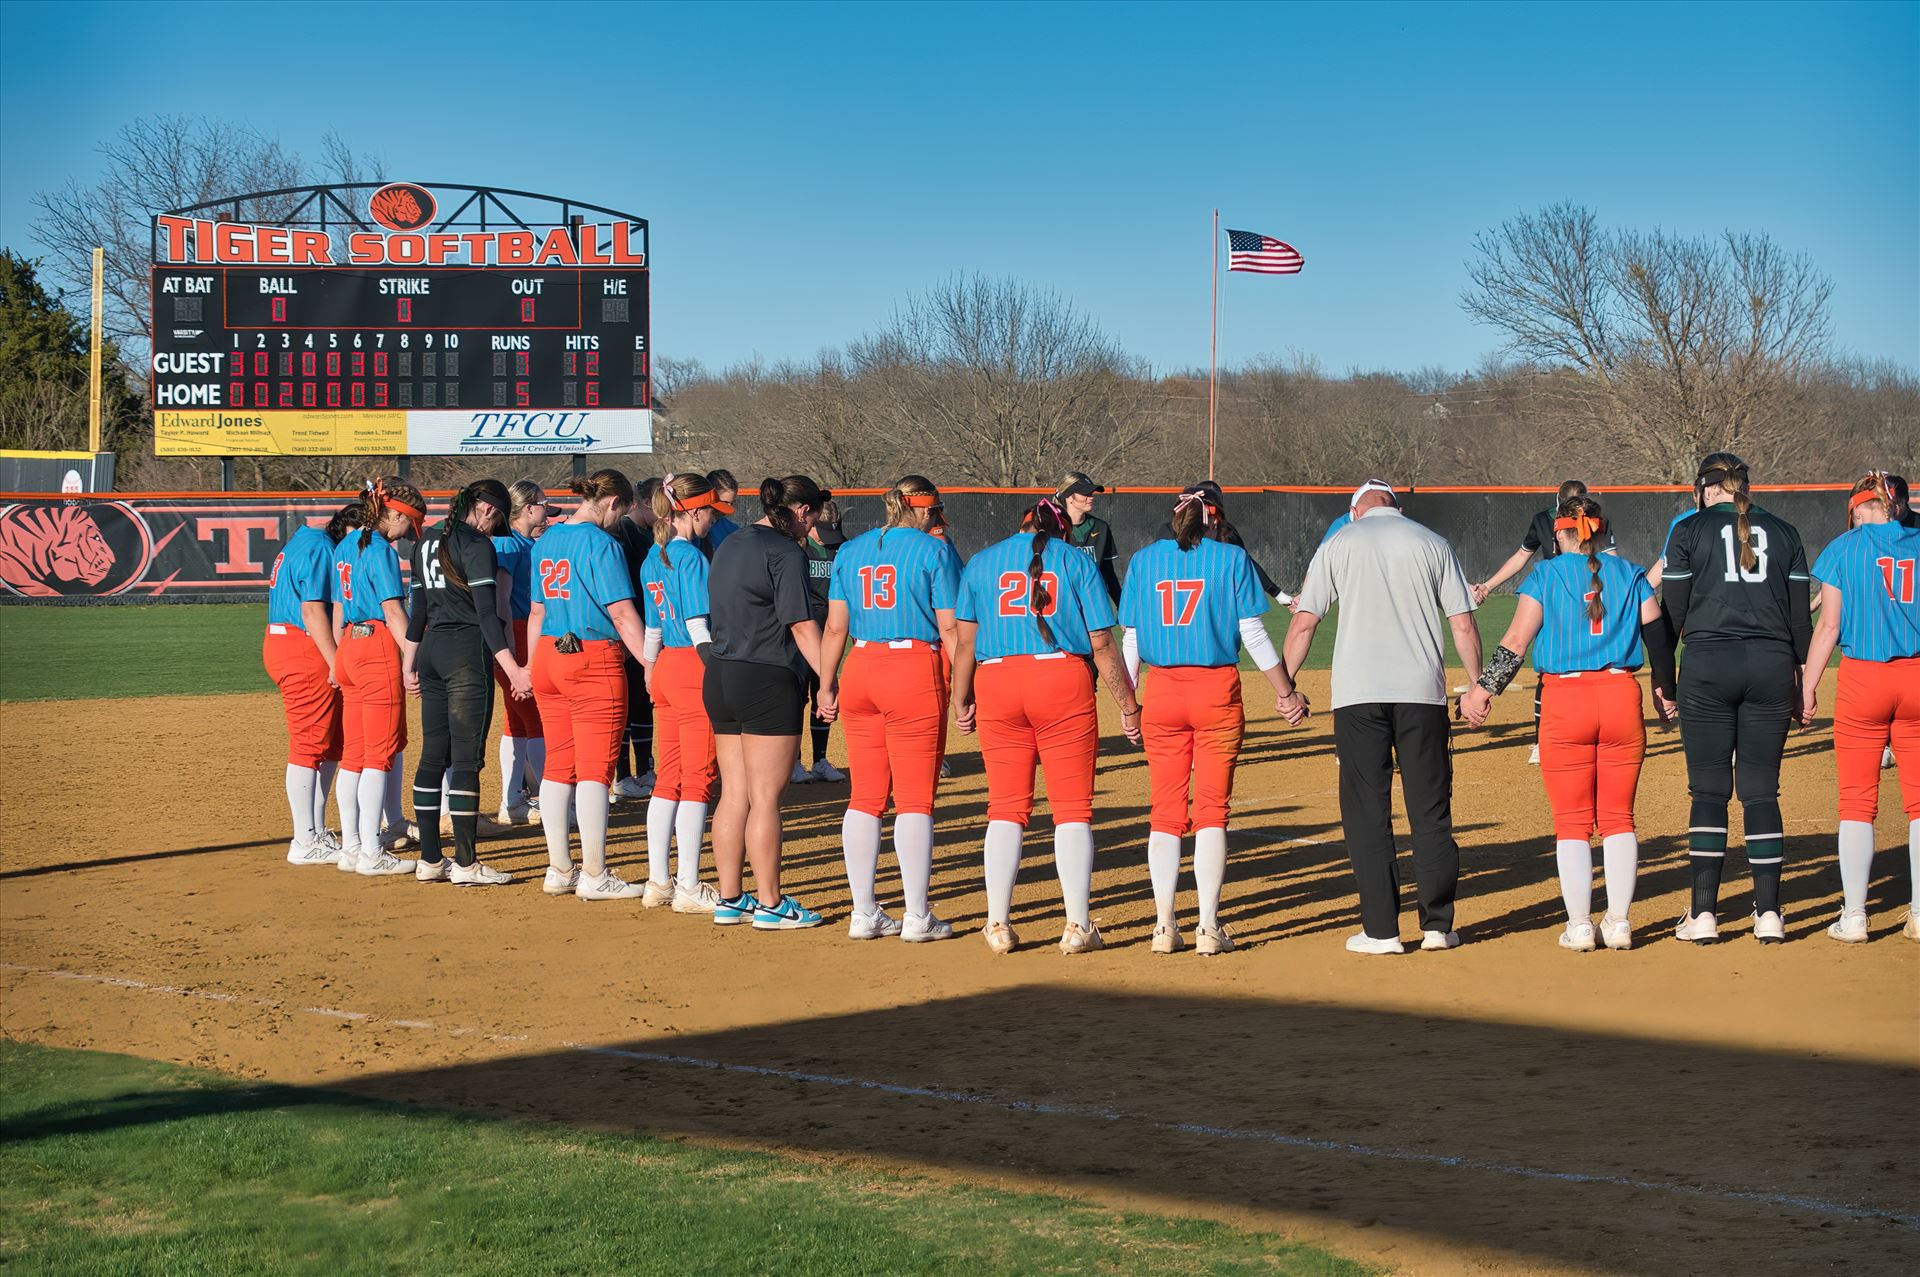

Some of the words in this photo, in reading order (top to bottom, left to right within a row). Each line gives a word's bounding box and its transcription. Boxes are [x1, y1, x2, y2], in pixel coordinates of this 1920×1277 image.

[157, 213, 336, 265] TIGER
[348, 220, 645, 266] SOFTBALL
[162, 277, 182, 293] AT
[185, 277, 214, 293] BAT
[259, 277, 298, 294] BALL
[379, 278, 430, 294] STRIKE
[511, 279, 545, 294] OUT
[603, 279, 627, 295] H/E
[234, 333, 239, 348] 1
[257, 333, 266, 348] 2
[281, 333, 290, 348] 3
[304, 333, 313, 348] 4
[329, 333, 338, 348] 5
[353, 333, 362, 348] 6
[376, 333, 385, 348] 7
[400, 333, 409, 348] 8
[425, 333, 433, 348] 9
[444, 333, 459, 348] 10
[491, 335, 531, 350] RUNS
[565, 335, 599, 350] HITS
[635, 335, 644, 350] E
[153, 352, 225, 374] GUEST
[157, 383, 221, 405] HOME
[161, 413, 215, 427] Edward
[216, 413, 262, 429] Jones
[469, 413, 590, 438] TFCU
[1721, 524, 1768, 582] 13
[421, 540, 446, 589] 12
[539, 558, 571, 600] 22
[858, 565, 897, 610] 13
[1876, 556, 1915, 603] 11
[1155, 579, 1205, 626] 17
